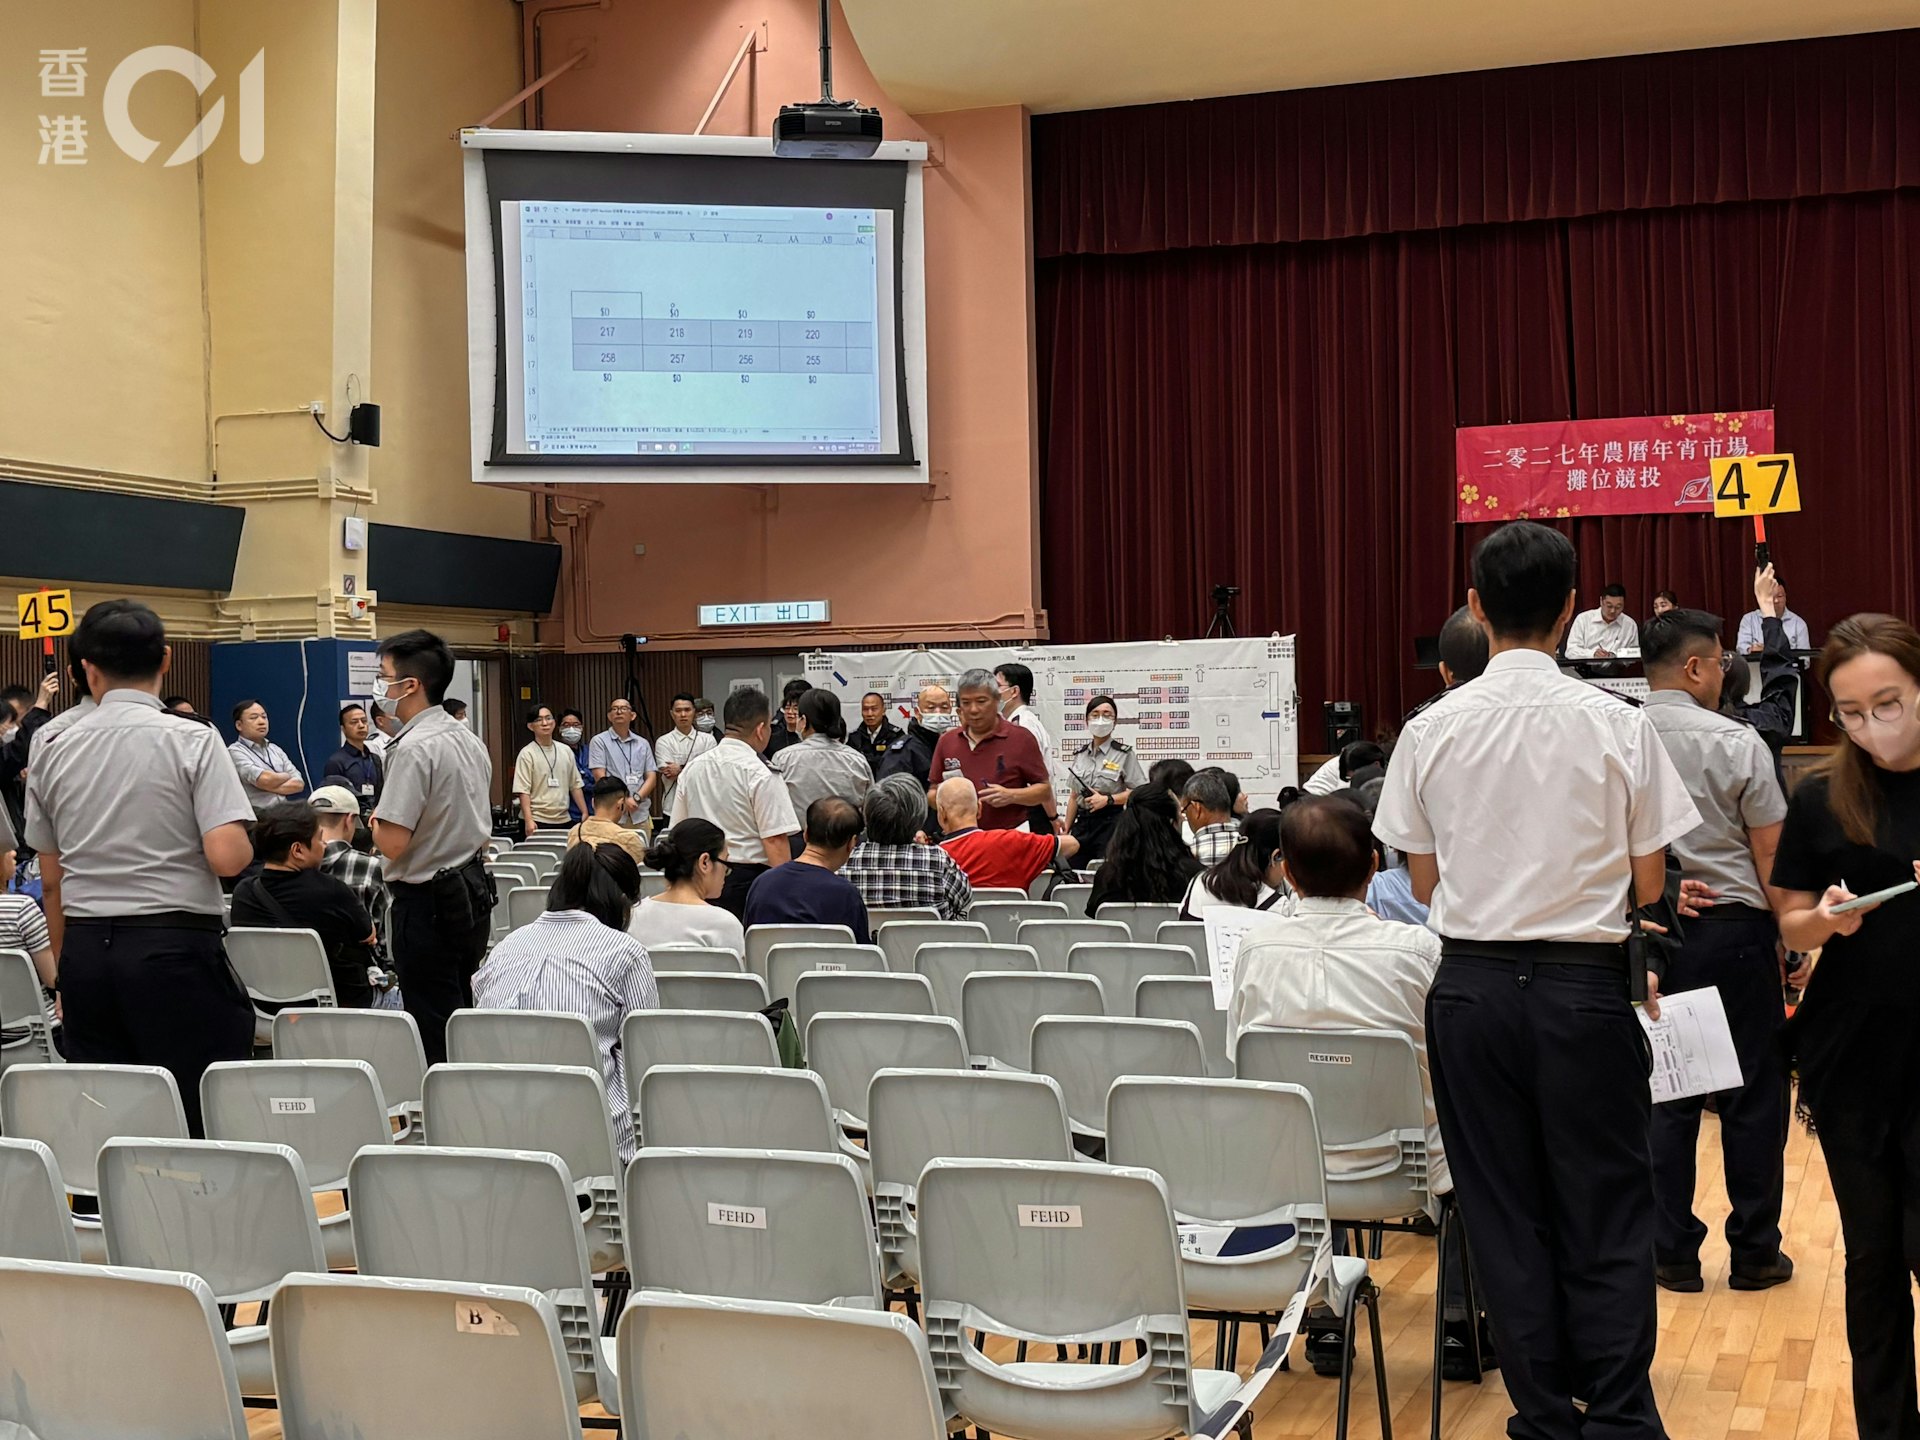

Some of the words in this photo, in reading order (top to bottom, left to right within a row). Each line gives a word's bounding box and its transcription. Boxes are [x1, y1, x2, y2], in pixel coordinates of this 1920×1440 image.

[653, 231, 661, 240] W
[689, 233, 695, 241] X
[723, 233, 729, 242] Y
[757, 234, 763, 243] Z
[788, 235, 799, 243] AA
[527, 308, 534, 316] 15
[600, 307, 610, 317] $0
[670, 308, 679, 318] $0
[738, 309, 747, 319] $0
[807, 310, 816, 319] $0
[600, 327, 615, 337] 217
[669, 328, 685, 338] 218
[738, 329, 753, 339] 219
[805, 330, 820, 340] 220
[601, 353, 616, 363] 258
[670, 354, 685, 364] 257
[738, 355, 753, 364] 256
[806, 356, 821, 365] 255
[603, 373, 612, 382] $0
[673, 373, 681, 383] $0
[741, 375, 749, 383] $0
[808, 375, 817, 384] $0
[1483, 436, 1749, 469] 二零二七年農曆年宵市場
[1567, 466, 1662, 492] 攤位競投
[1717, 460, 1789, 510] 47
[21, 594, 69, 634] 45
[716, 605, 761, 622] EXIT
[777, 604, 809, 620] 出口
[1310, 1054, 1351, 1062] RESERVED
[279, 1102, 307, 1111] FEHD
[719, 1209, 755, 1223] FEHD
[1031, 1210, 1070, 1222] FEHD
